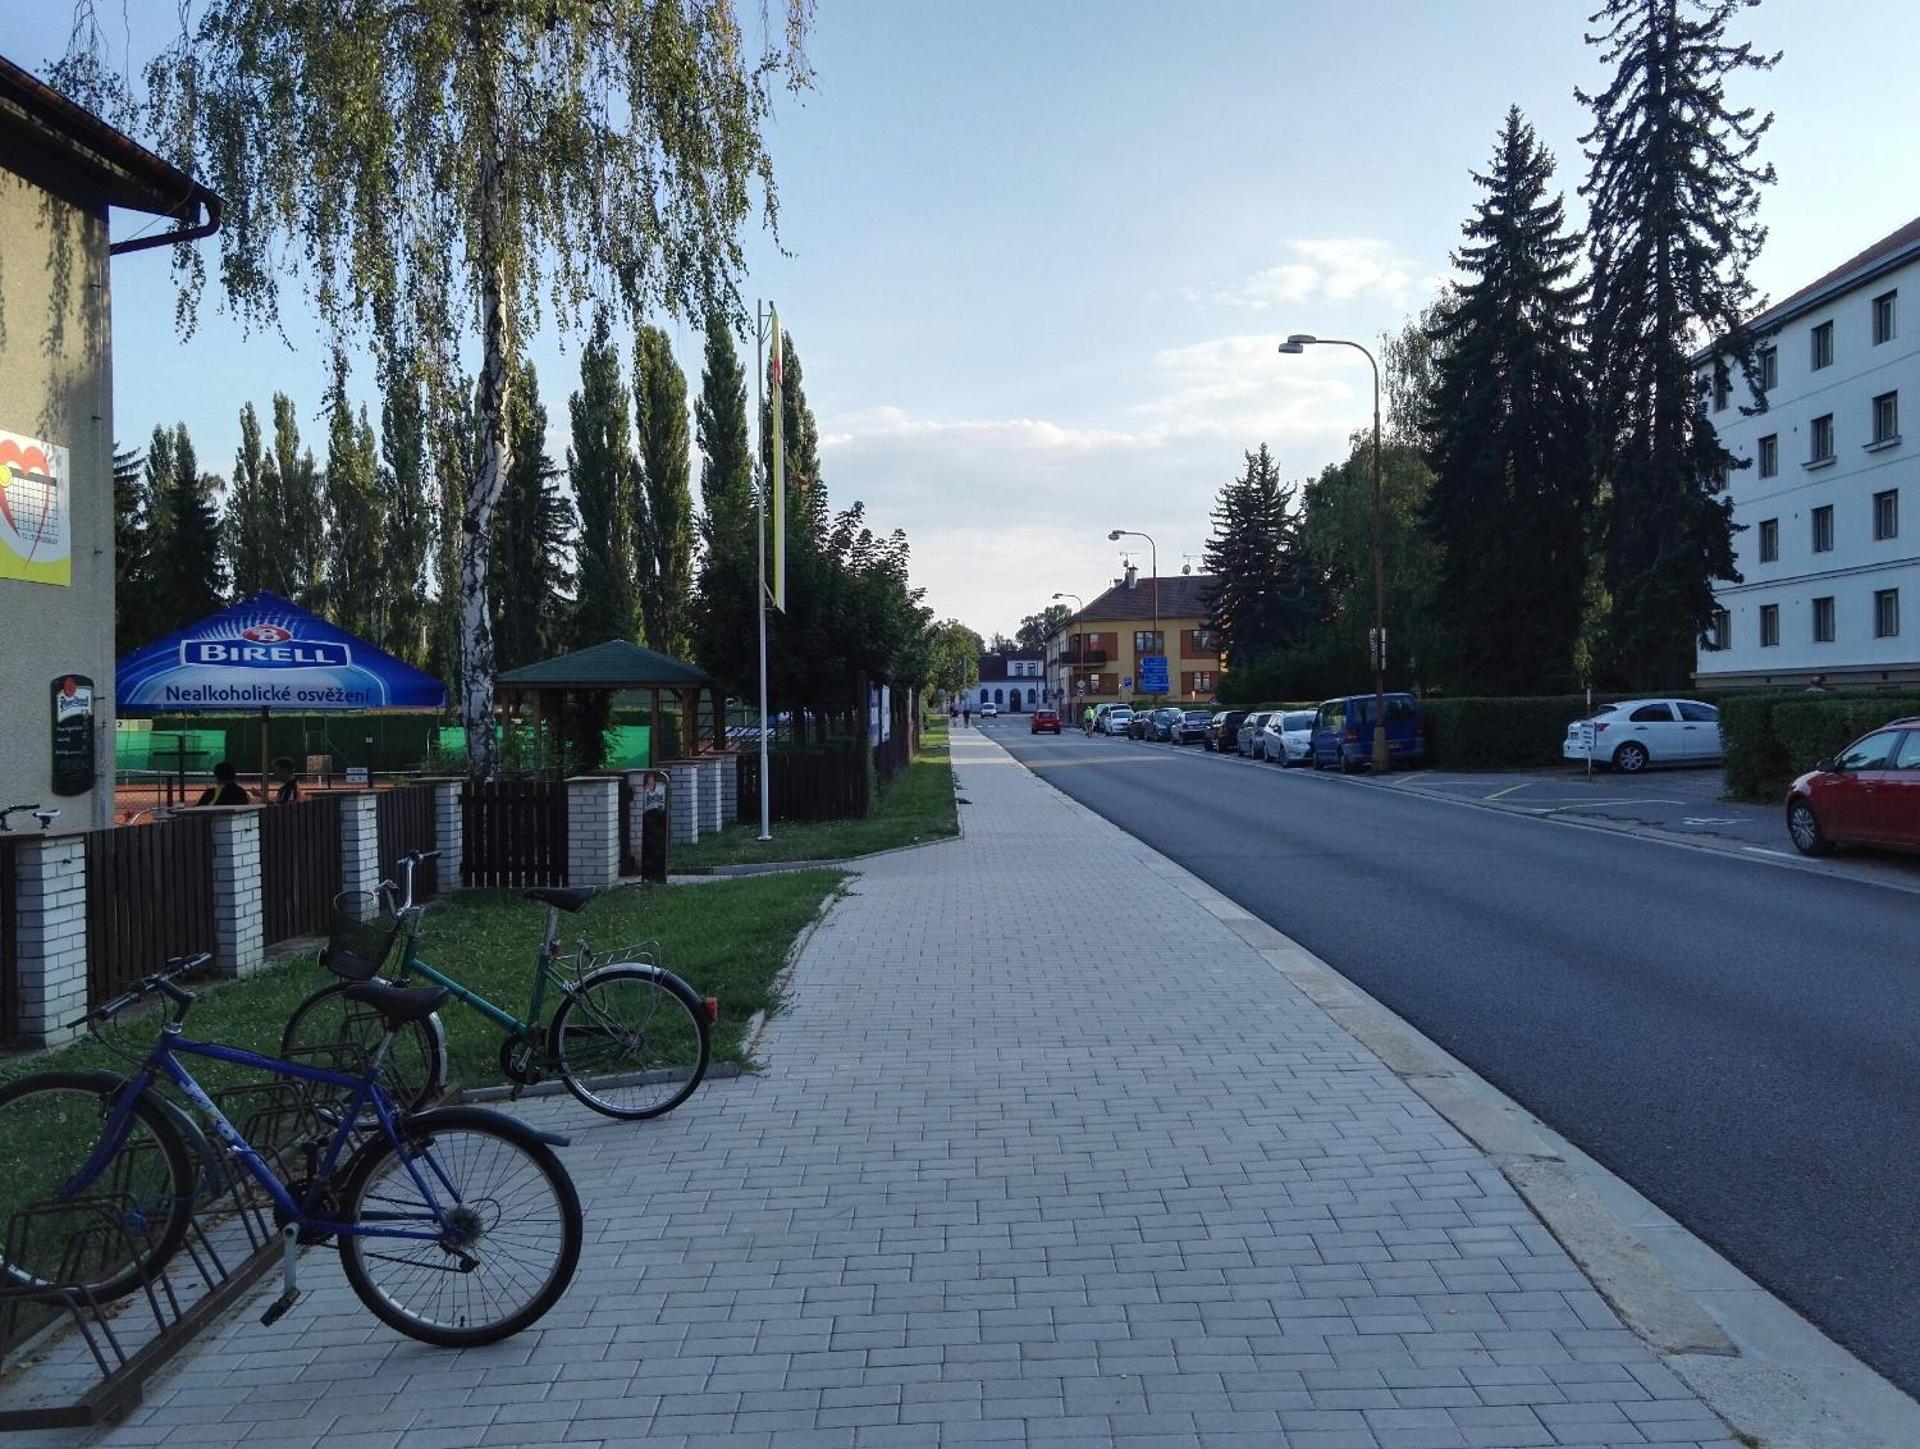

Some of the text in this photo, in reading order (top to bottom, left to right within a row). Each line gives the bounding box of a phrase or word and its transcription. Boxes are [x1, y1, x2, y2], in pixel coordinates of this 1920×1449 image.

[200, 644, 337, 664] BIRELL
[165, 684, 370, 702] Nealkoholické osvěžení
